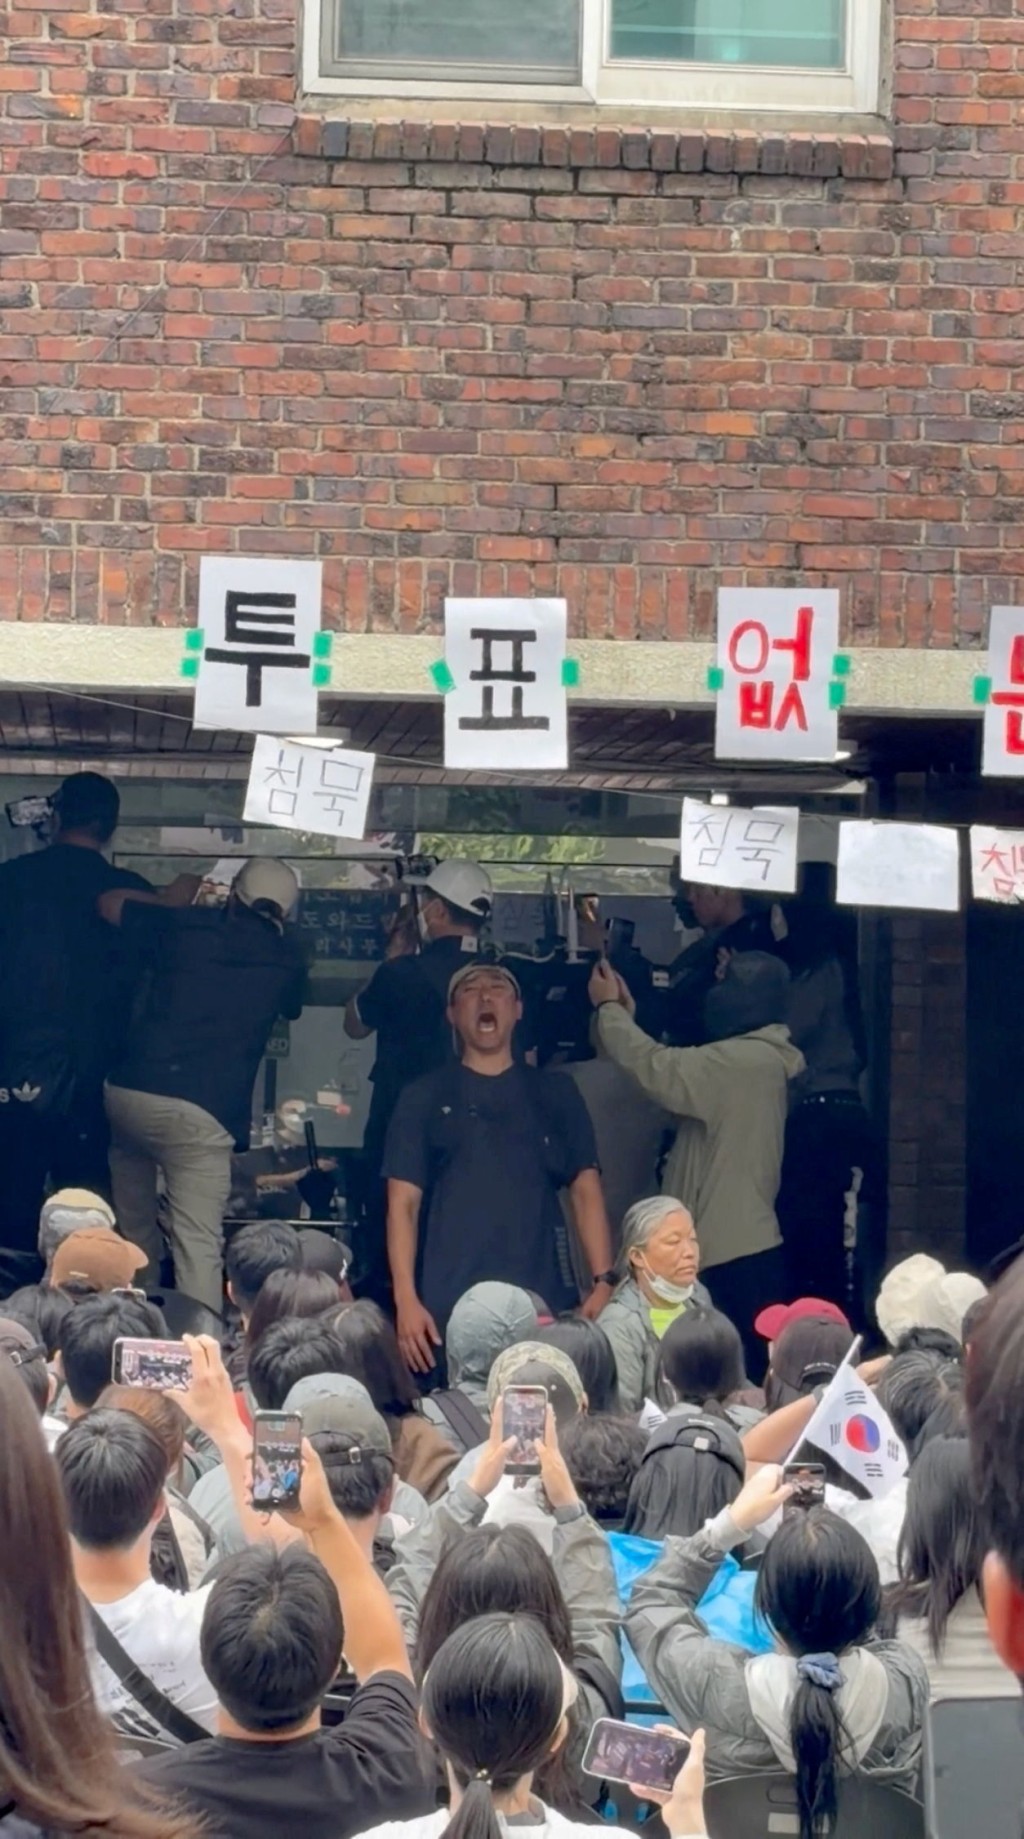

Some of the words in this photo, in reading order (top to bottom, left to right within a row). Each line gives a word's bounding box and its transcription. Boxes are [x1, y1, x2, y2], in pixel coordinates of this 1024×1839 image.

[204, 590, 311, 707] 투
[458, 628, 550, 731] 표
[728, 606, 814, 732] 없
[263, 749, 365, 827] 침묵
[688, 813, 785, 881] 침묵
[979, 842, 1024, 896] 침
